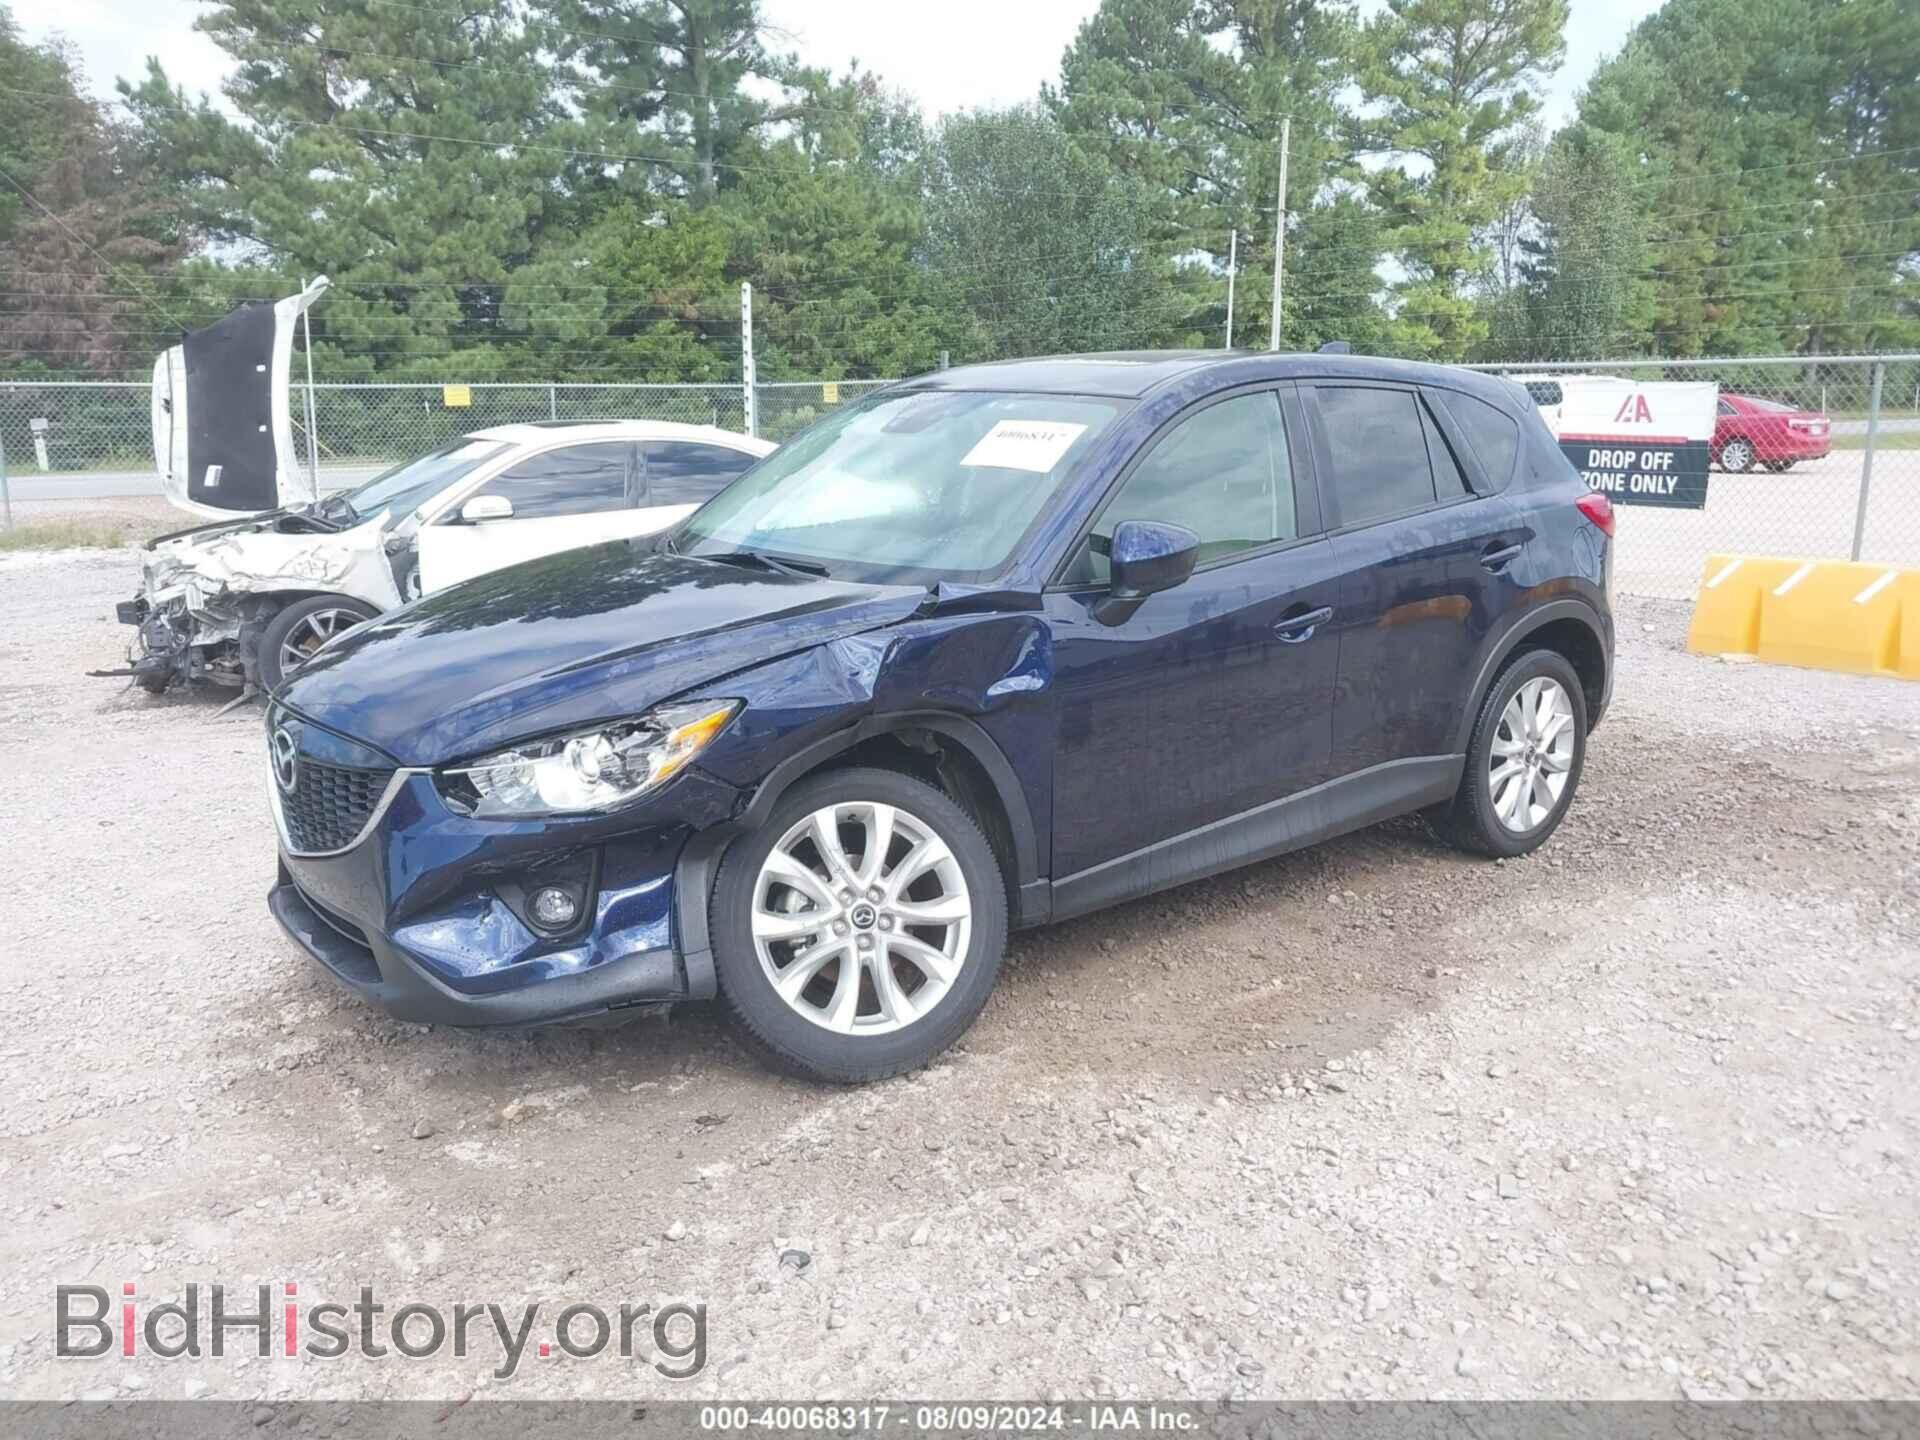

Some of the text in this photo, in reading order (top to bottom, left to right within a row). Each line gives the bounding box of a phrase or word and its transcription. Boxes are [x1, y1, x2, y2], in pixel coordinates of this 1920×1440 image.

[1588, 449, 1675, 471] DROP OFF
[1630, 473, 1679, 495] ONLY
